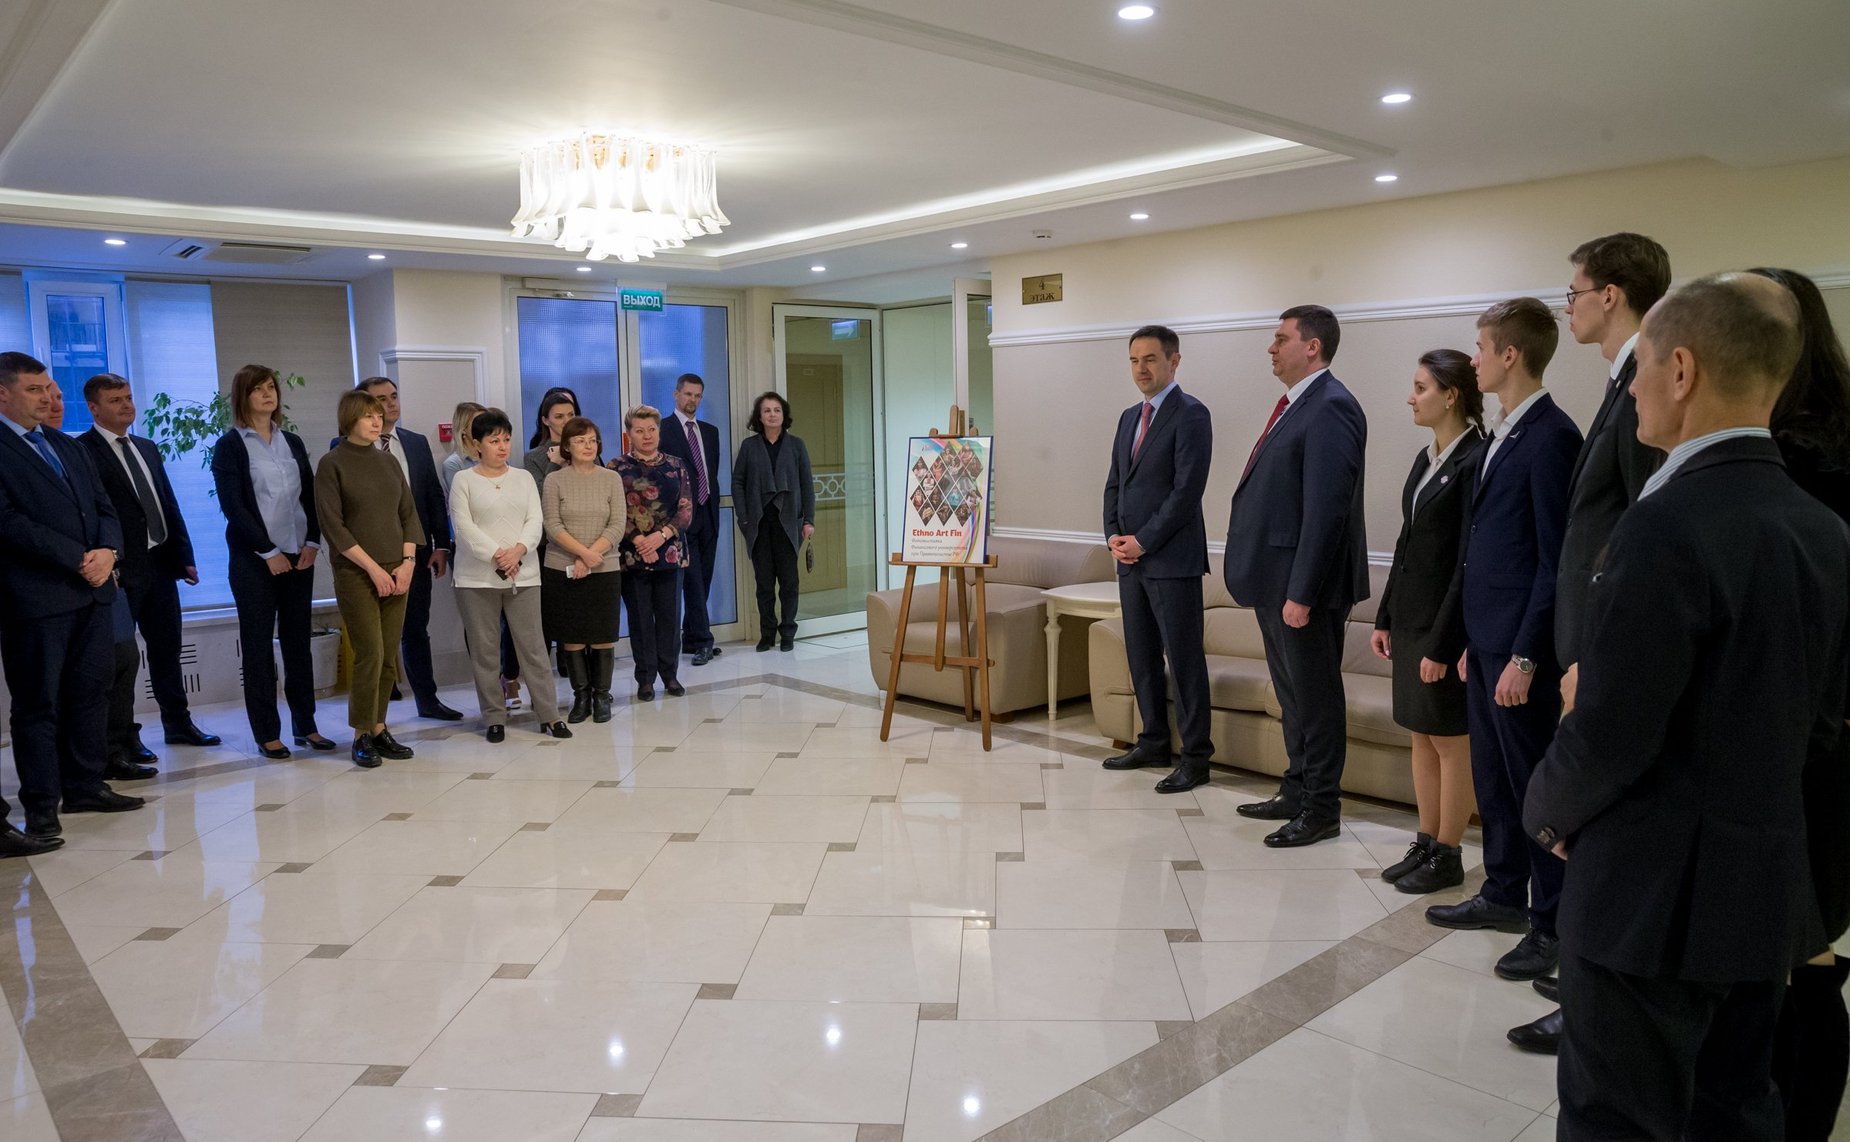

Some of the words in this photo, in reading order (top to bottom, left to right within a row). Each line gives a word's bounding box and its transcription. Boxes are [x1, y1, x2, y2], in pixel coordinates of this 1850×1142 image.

[1039, 280, 1045, 290] 4
[623, 294, 661, 308] ВЫХОД
[912, 529, 934, 537] Ethno
[936, 529, 948, 537] Art
[950, 529, 962, 537] Fin
